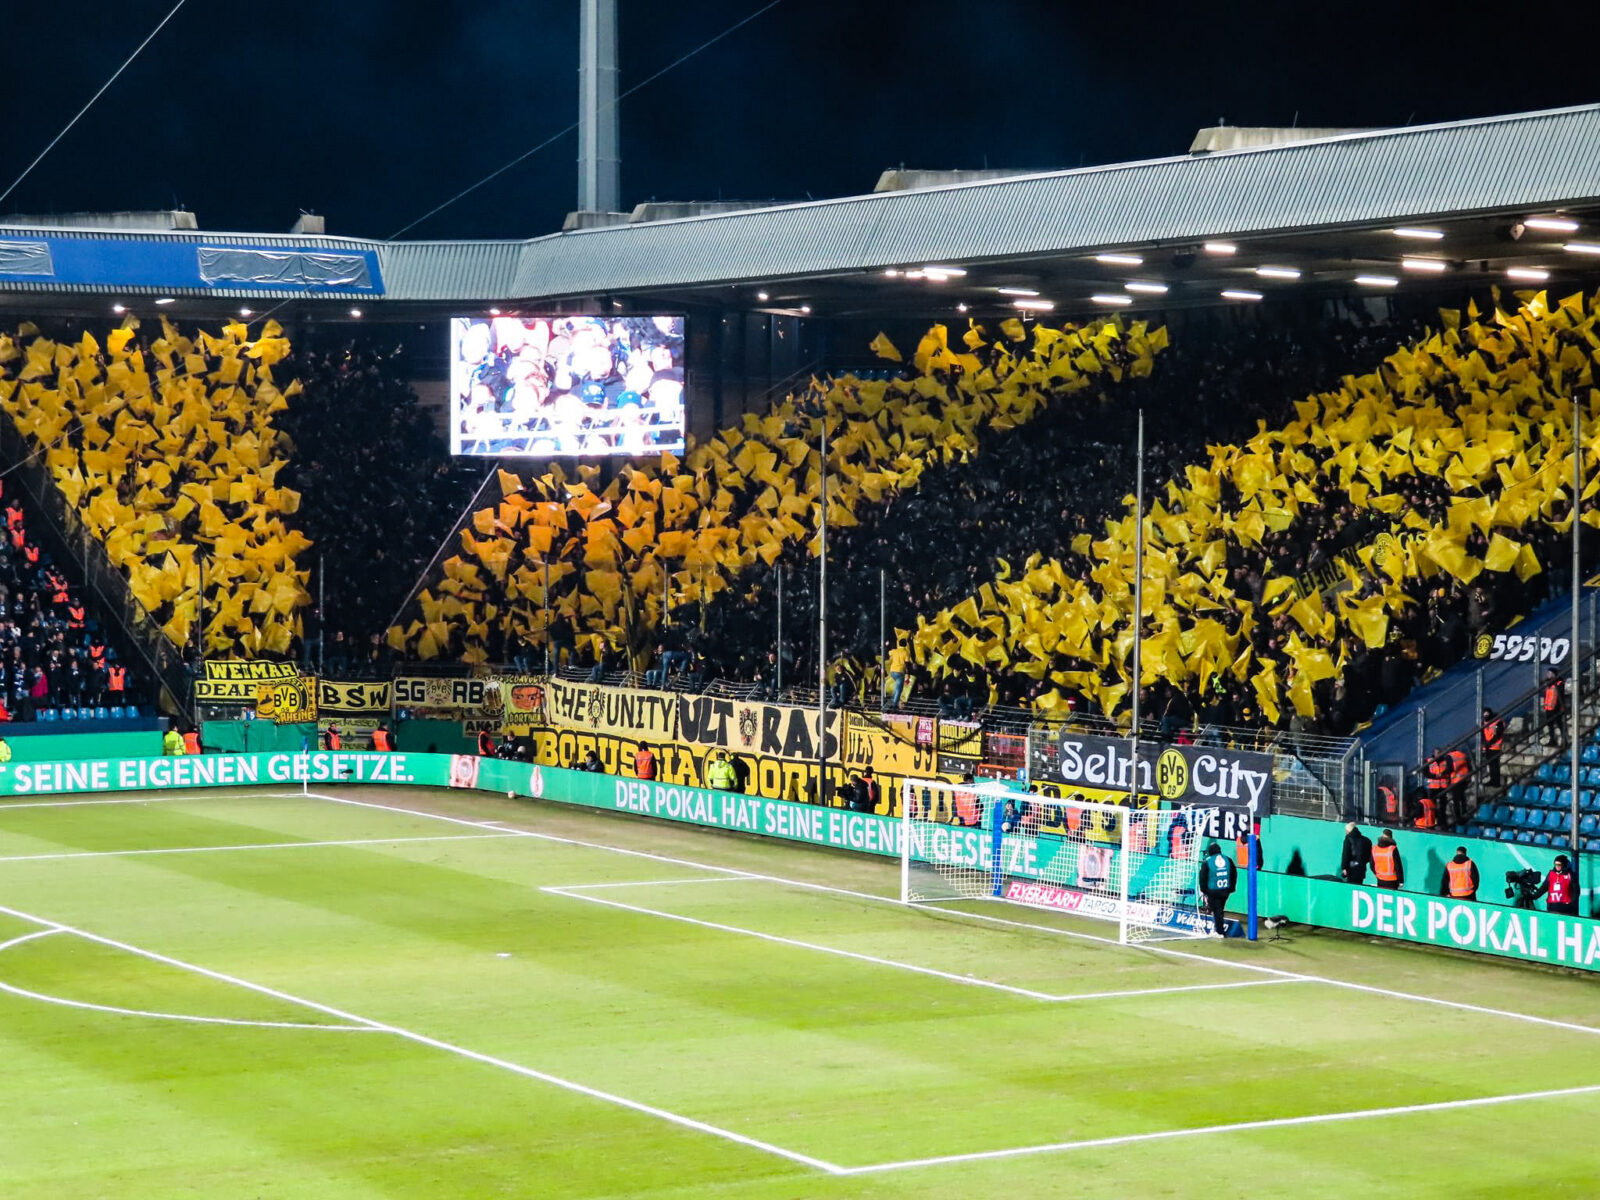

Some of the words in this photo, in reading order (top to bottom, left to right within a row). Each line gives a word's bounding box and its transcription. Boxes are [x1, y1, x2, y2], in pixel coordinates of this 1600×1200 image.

[1490, 634, 1570, 665] 59590
[209, 662, 297, 679] WEIMAR
[197, 684, 256, 697] DEAF
[274, 687, 298, 707] BVB
[322, 684, 389, 707] BSW
[395, 680, 426, 702] SG
[452, 681, 485, 704] RB
[551, 682, 588, 721] THE
[607, 693, 675, 732] UNITY
[14, 761, 109, 793] SEINE
[119, 756, 258, 788] EIGENEN
[267, 753, 414, 782] GESETZE.
[1061, 741, 1153, 790] Selm
[1161, 755, 1184, 784] BVB
[1192, 753, 1268, 811] City
[615, 780, 650, 813] DER
[655, 786, 717, 823] POKAL
[722, 796, 760, 830] HAT
[765, 802, 823, 841] SEINE
[1007, 883, 1080, 907] FLYERALARM
[1550, 892, 1563, 902] TV
[1352, 889, 1417, 937] DER
[1428, 901, 1547, 959] POKAL
